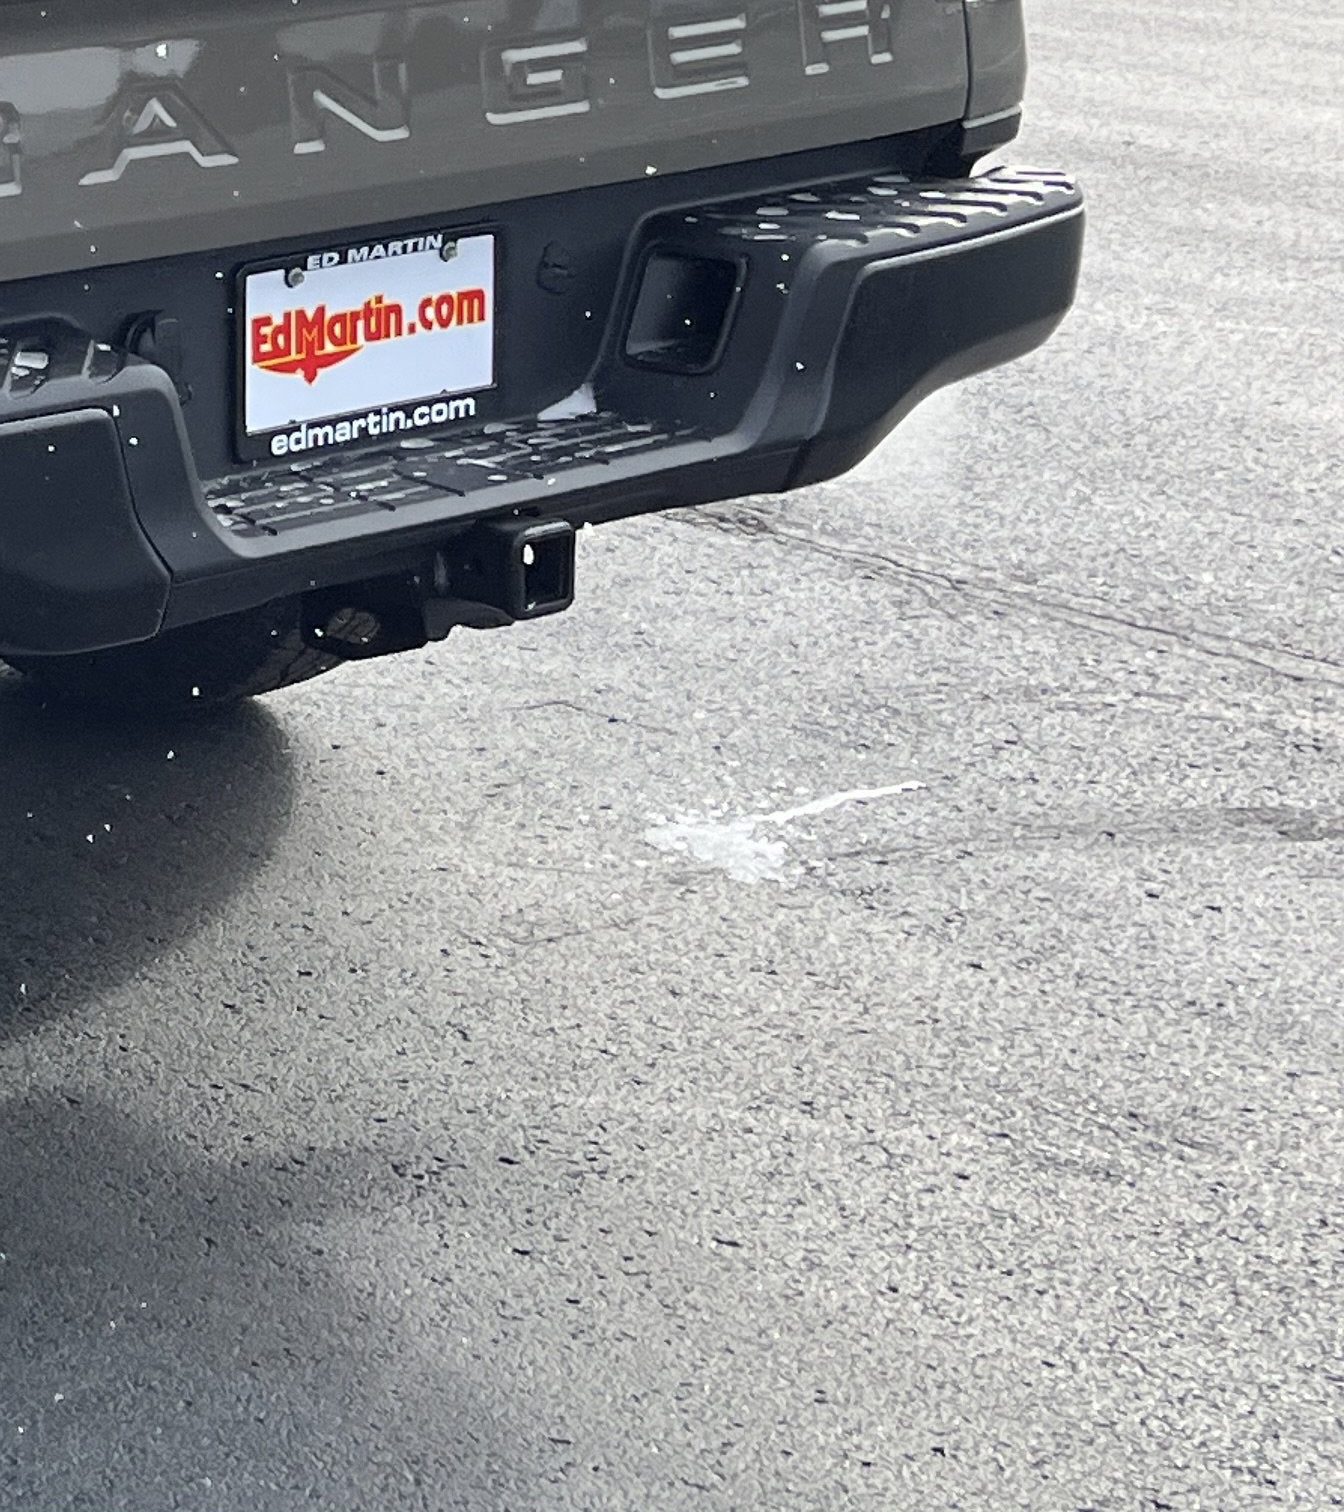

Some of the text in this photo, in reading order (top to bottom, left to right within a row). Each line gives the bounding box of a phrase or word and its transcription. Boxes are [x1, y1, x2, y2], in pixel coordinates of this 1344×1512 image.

[307, 234, 444, 271] ED MARTIN
[250, 288, 486, 366] EdMartin.com
[269, 396, 476, 457] edmartin.com
